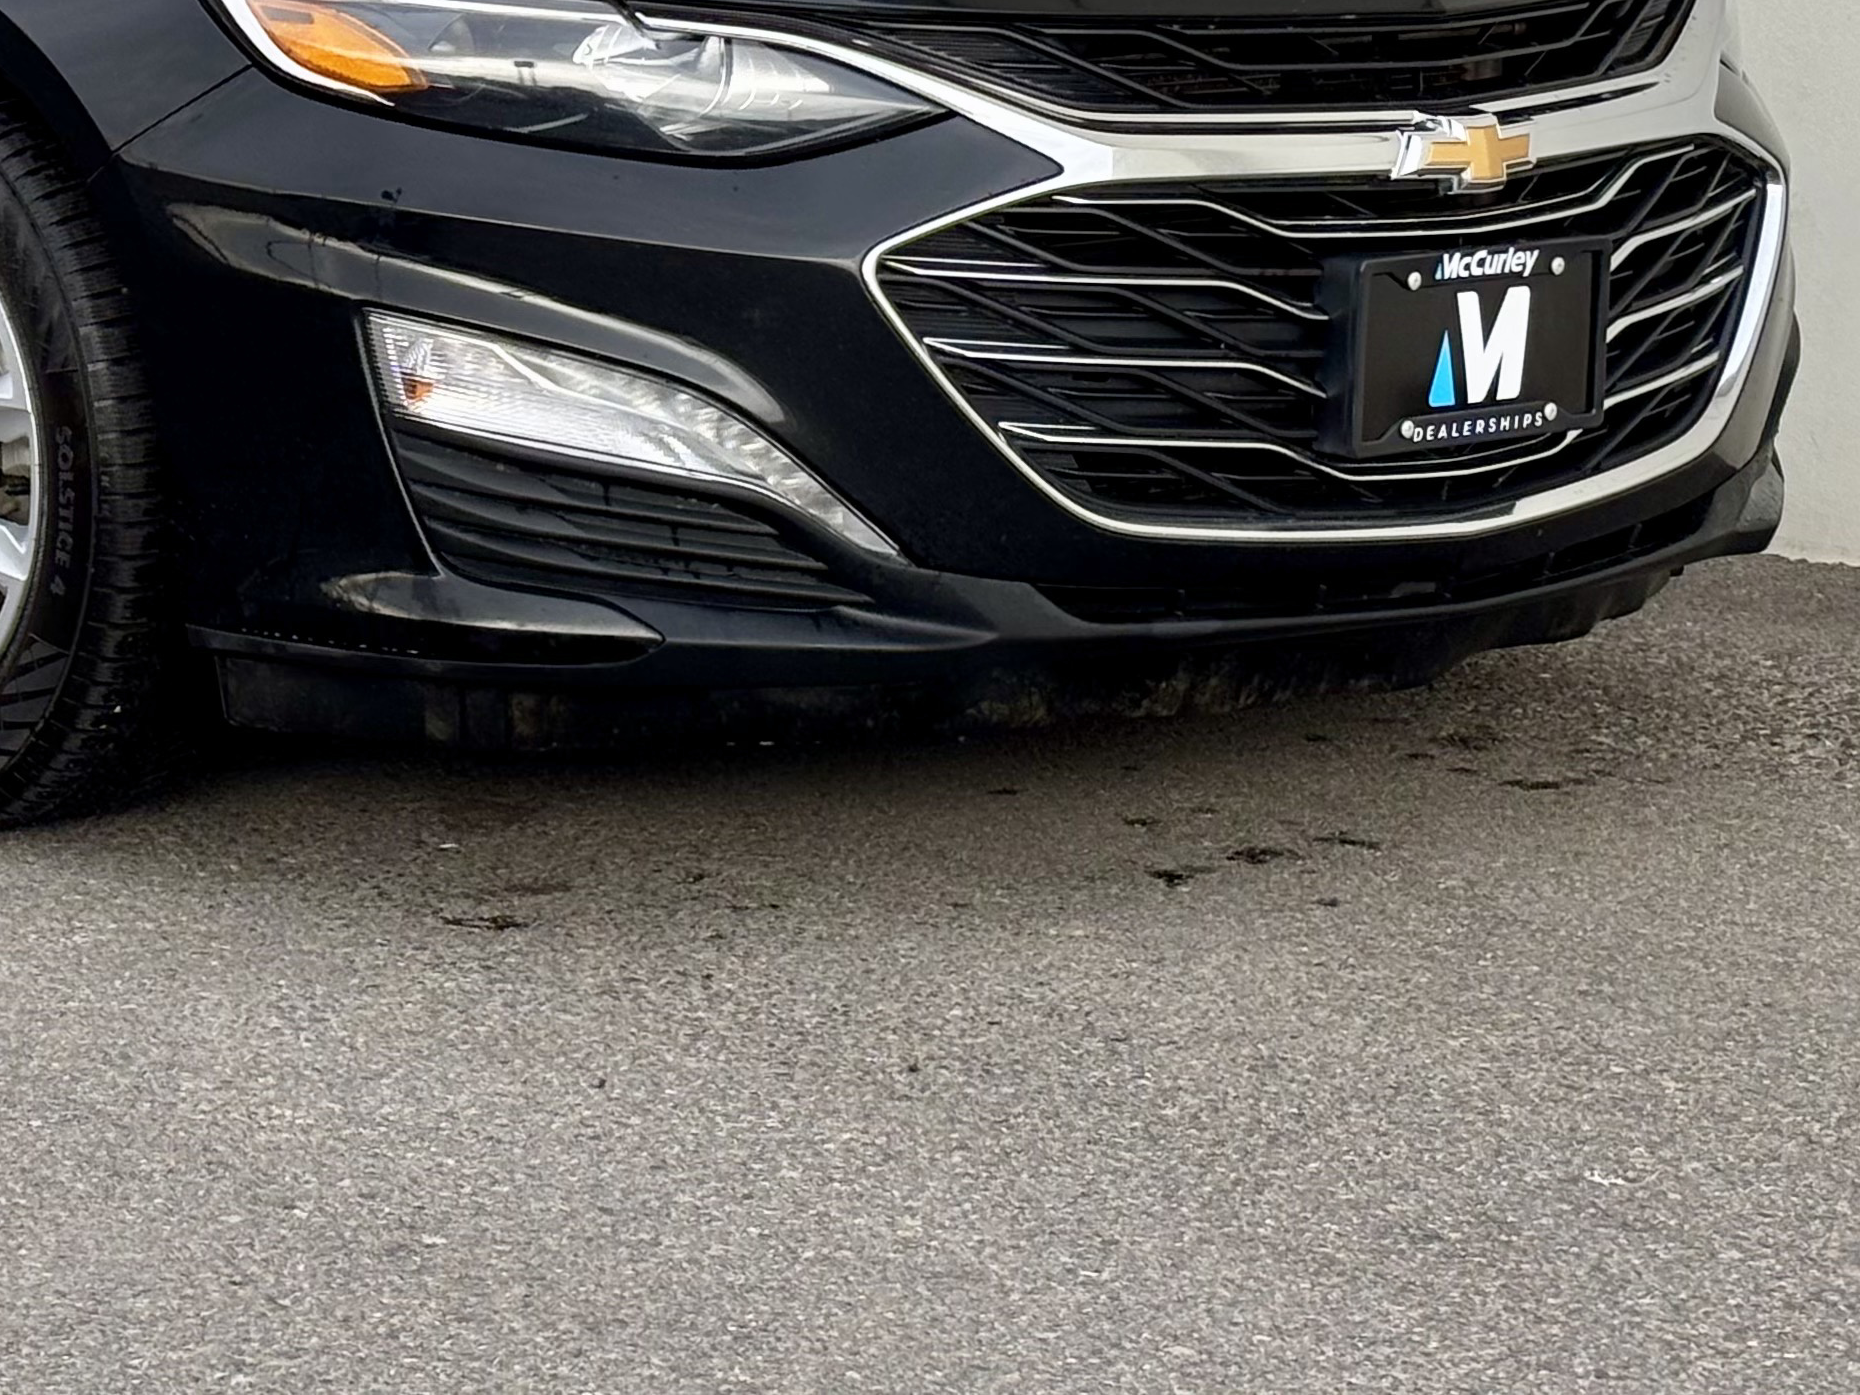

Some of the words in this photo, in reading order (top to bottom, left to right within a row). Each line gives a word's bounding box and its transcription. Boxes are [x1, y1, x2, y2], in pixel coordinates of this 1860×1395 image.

[1435, 247, 1540, 281] McCurley
[1412, 410, 1544, 443] DEALERSHIPS
[55, 425, 76, 569] SOLSTICE
[50, 574, 66, 596] 4
